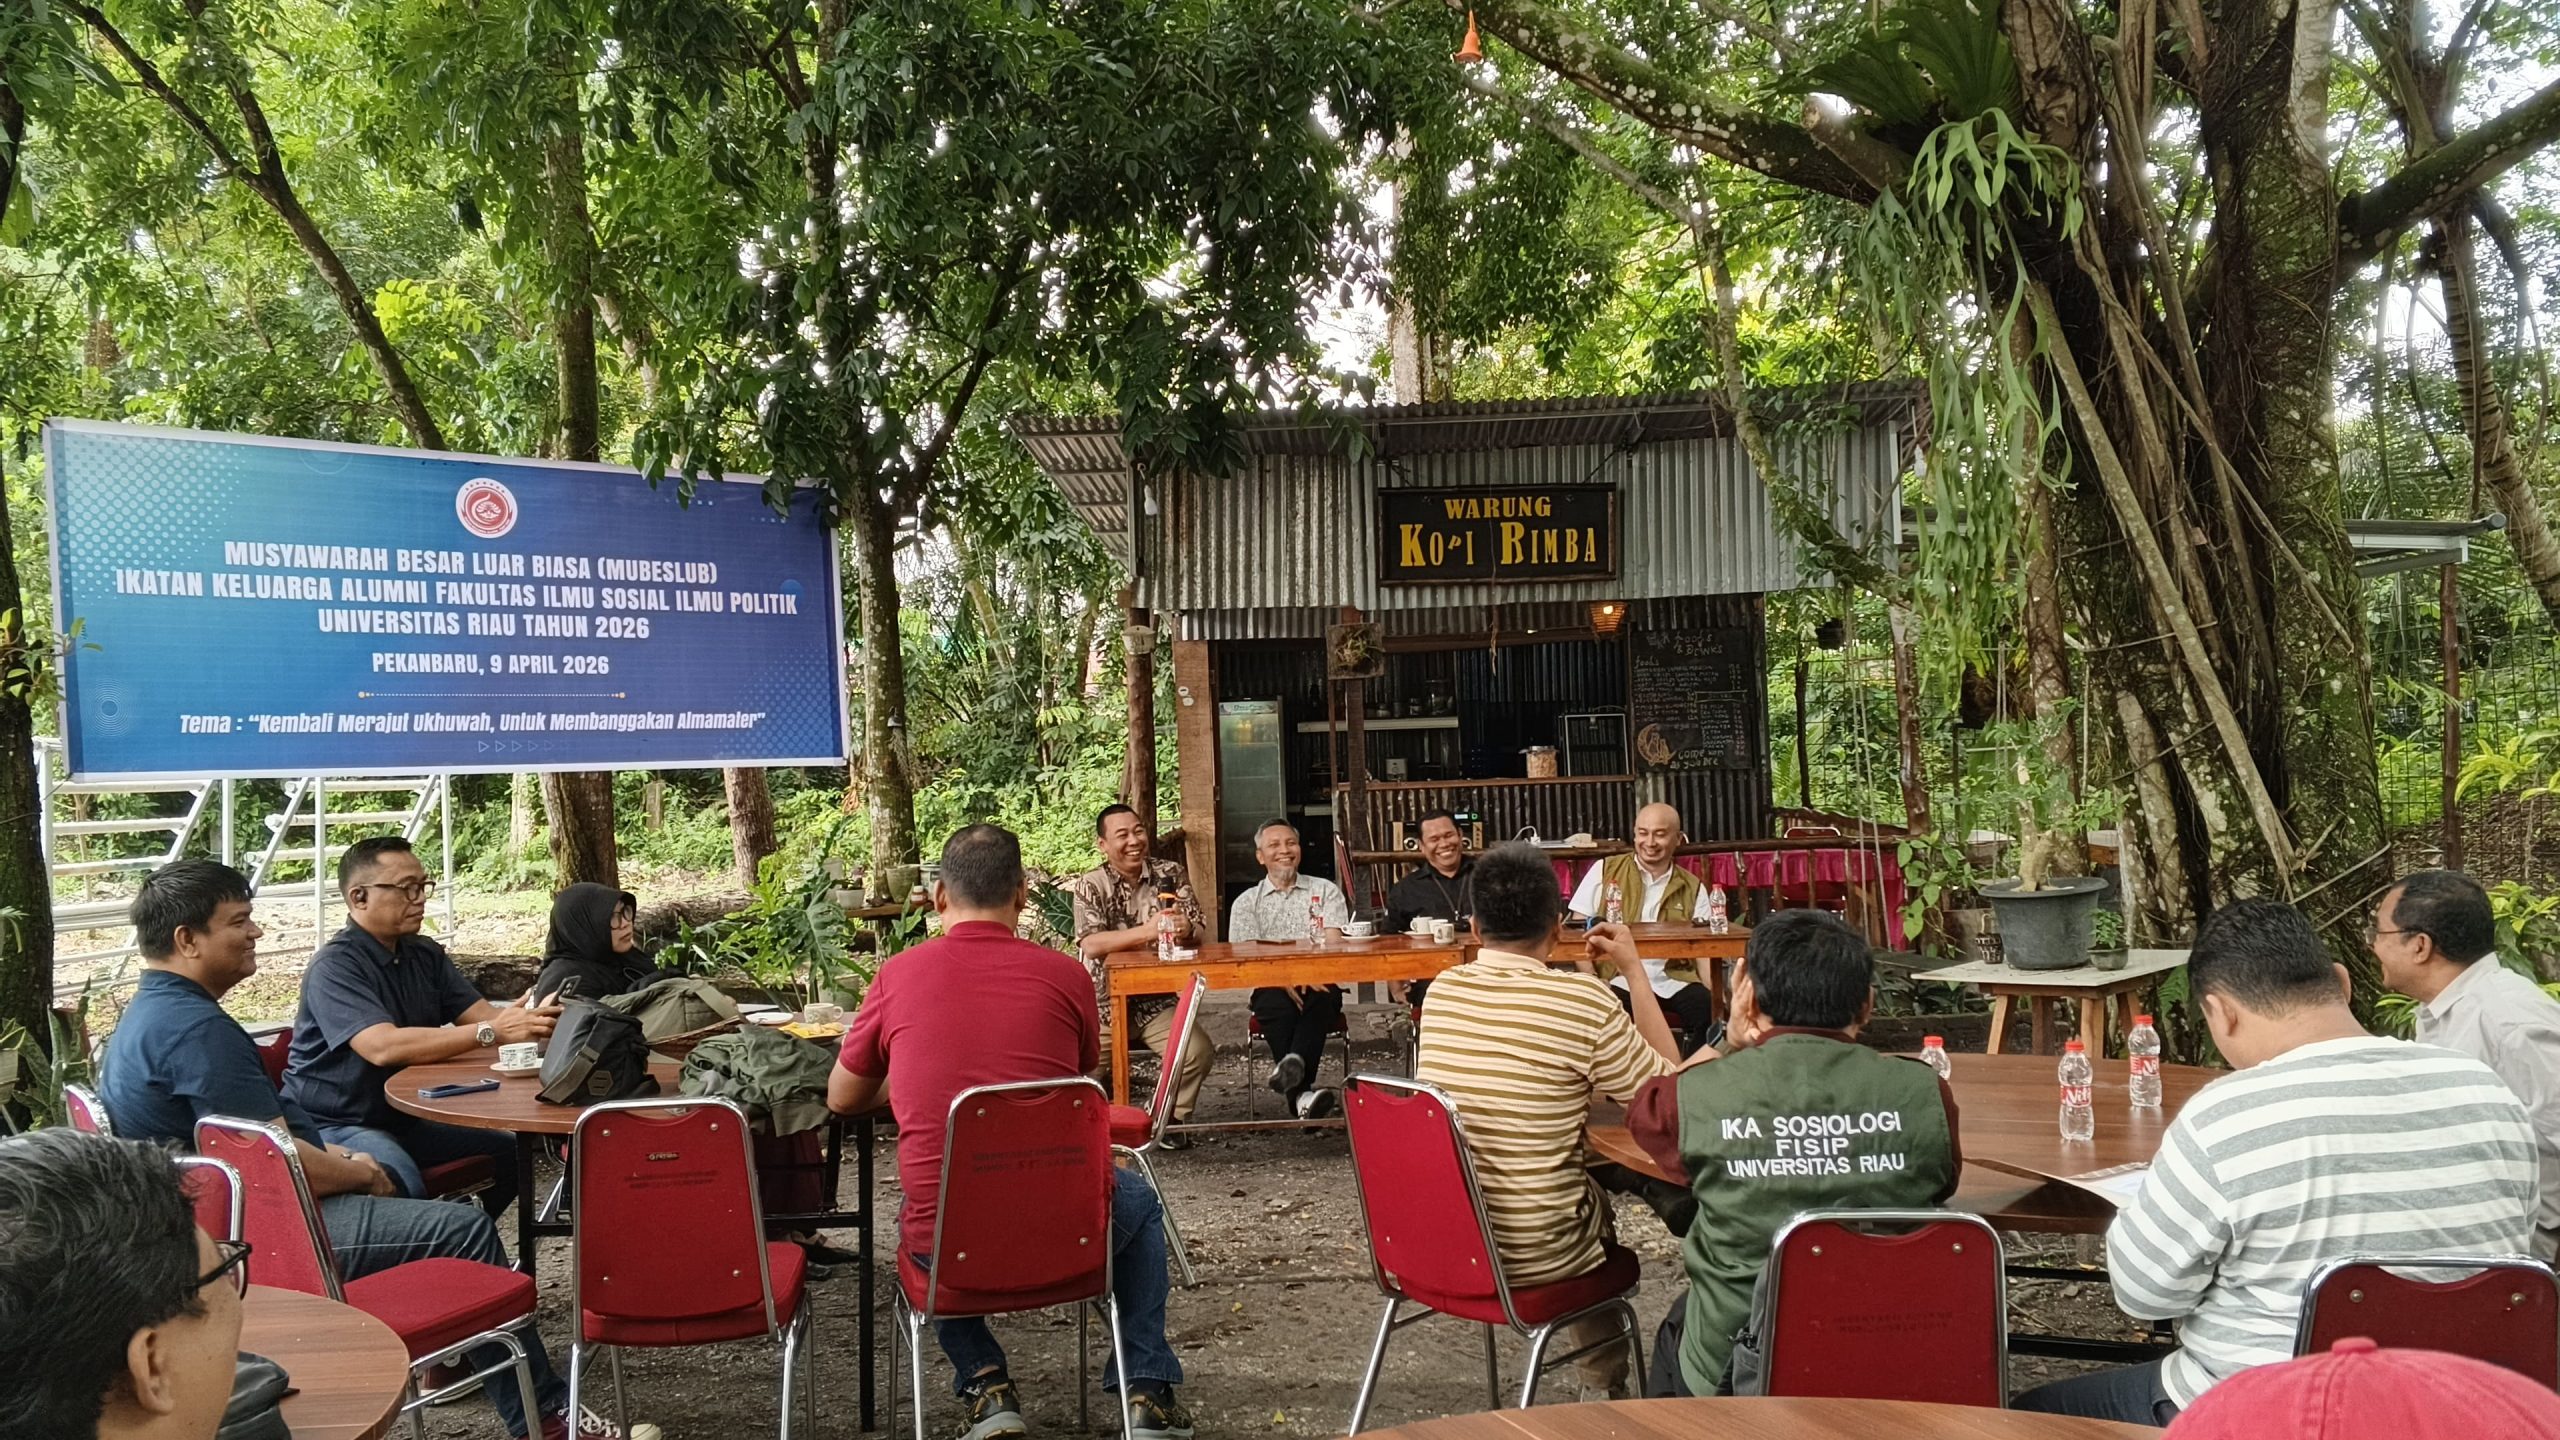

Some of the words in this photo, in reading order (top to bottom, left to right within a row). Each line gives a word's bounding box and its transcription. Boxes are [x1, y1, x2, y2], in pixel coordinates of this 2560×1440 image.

[1444, 496, 1552, 519] WARUNG
[1500, 521, 1597, 565] RIMBA
[224, 541, 389, 571] MUSYAWARAH
[397, 548, 465, 575] BESAR
[472, 552, 525, 576] LUAR
[532, 555, 591, 579] BIASA
[597, 556, 718, 584] (MUBESLUB)
[116, 569, 203, 596] IKATAN
[212, 573, 333, 601] KELUARGA
[341, 577, 428, 603] ALUMNI
[435, 580, 536, 607] FAKULTAS
[543, 585, 595, 609] ILMU
[601, 587, 670, 611] SOSIAL
[675, 590, 724, 613] ILMU
[730, 592, 798, 615] POLITIK
[318, 608, 460, 635] UNIVERSITAS
[467, 612, 516, 636] RIAU
[523, 614, 589, 638] TAHUN
[595, 616, 650, 639] 2026
[372, 652, 485, 676] PEKANBARU,
[490, 654, 502, 674] 9
[508, 654, 558, 674] APRIL
[562, 655, 610, 675] 2026
[180, 714, 232, 734] Tema
[248, 712, 334, 734] “Kembali
[337, 713, 409, 734] Merajut
[413, 712, 495, 733] Ukhuwah,
[500, 711, 546, 731] Untuk
[549, 711, 674, 732] Membanggakan
[676, 711, 766, 729] Almamater”
[1721, 1117, 1762, 1140] IKA
[1772, 1111, 1902, 1137] SOSIOLOGI
[1775, 1138, 1850, 1157] FISIP
[1726, 1155, 1851, 1178] UNIVERSITAS
[1859, 1152, 1905, 1173] RIAU
